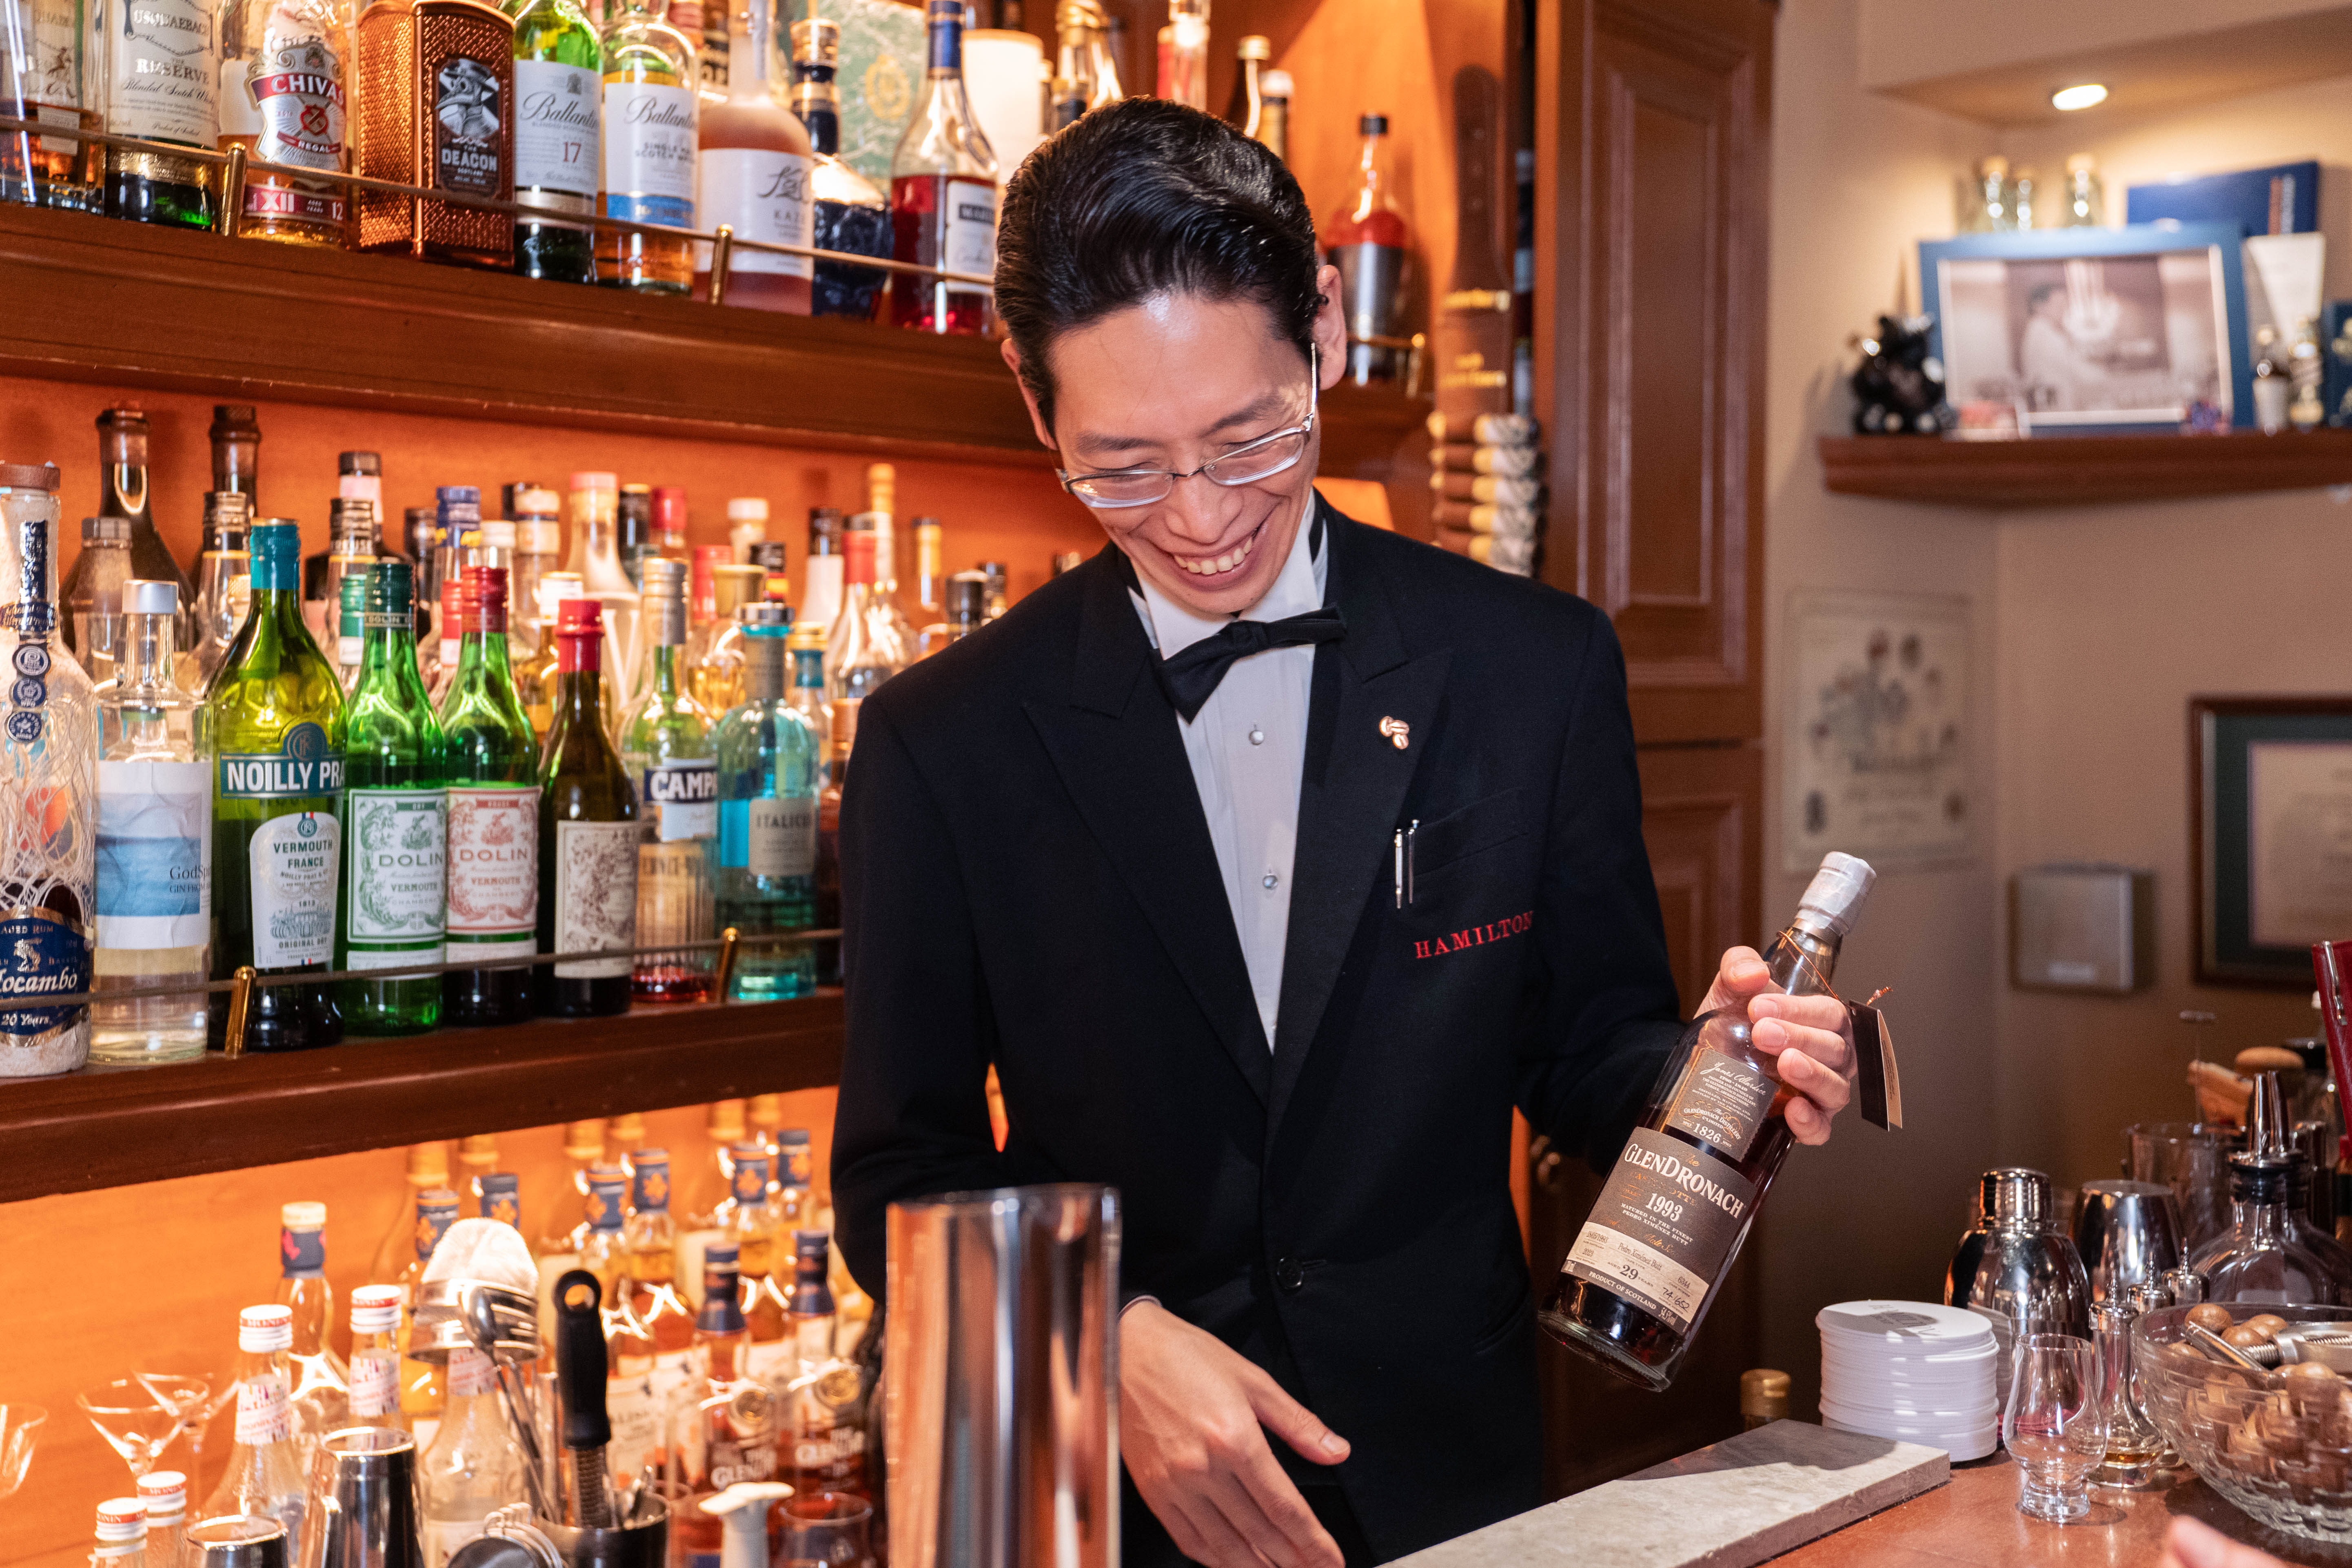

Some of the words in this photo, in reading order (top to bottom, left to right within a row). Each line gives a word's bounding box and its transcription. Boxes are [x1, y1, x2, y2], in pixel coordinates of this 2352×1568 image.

[135, 58, 209, 84] RESERVE
[271, 74, 344, 106] CHIVAS
[297, 140, 330, 153] REGAL
[563, 142, 581, 163] 17
[442, 149, 497, 172] DEACON
[261, 191, 294, 212] XII
[228, 761, 313, 791] NOILLY
[274, 840, 333, 853] VERMOUTH
[460, 848, 527, 862] DOLIN
[288, 856, 324, 868] FRANCE
[379, 853, 442, 867] DOLIN
[170, 884, 185, 894] GIN
[391, 882, 437, 892] VERMOUTH
[472, 877, 520, 885] VERMOUTH
[279, 939, 314, 949] ORIGINAL
[1414, 911, 1533, 959] HAMILTON
[2, 1014, 18, 1026] 20
[1700, 1062, 1735, 1077] James
[1734, 1074, 1766, 1096] Allardice
[1708, 1075, 1724, 1085] PIONEER
[1731, 1087, 1748, 1097] FOUNDER
[1709, 1080, 1736, 1096] GLENDRONACH
[1692, 1089, 1710, 1099] BOTTLED
[1722, 1098, 1742, 1111] MATURED
[1693, 1123, 1722, 1143] 1826
[1719, 1117, 1742, 1140] DISTILLERY
[1645, 1193, 1683, 1222] 1993
[1621, 1203, 1648, 1217] MATURED
[1658, 1219, 1671, 1229] THE
[1672, 1227, 1693, 1242] FINEST
[1622, 1209, 1642, 1221] PEDRO
[1643, 1218, 1670, 1235] XIMÉNEZ
[1672, 1234, 1688, 1246] BUTT
[1582, 1248, 1594, 1257] 2023
[1618, 1242, 1631, 1254] Pedro
[1631, 1248, 1651, 1264] Ximénez
[1651, 1259, 1663, 1271] Butt
[1620, 1265, 1638, 1280] 29
[1638, 1277, 1654, 1287] YEARS
[1677, 1276, 1691, 1289] 6344
[1589, 1271, 1615, 1287] PRODUCT
[1625, 1289, 1657, 1310] SCOTLAND
